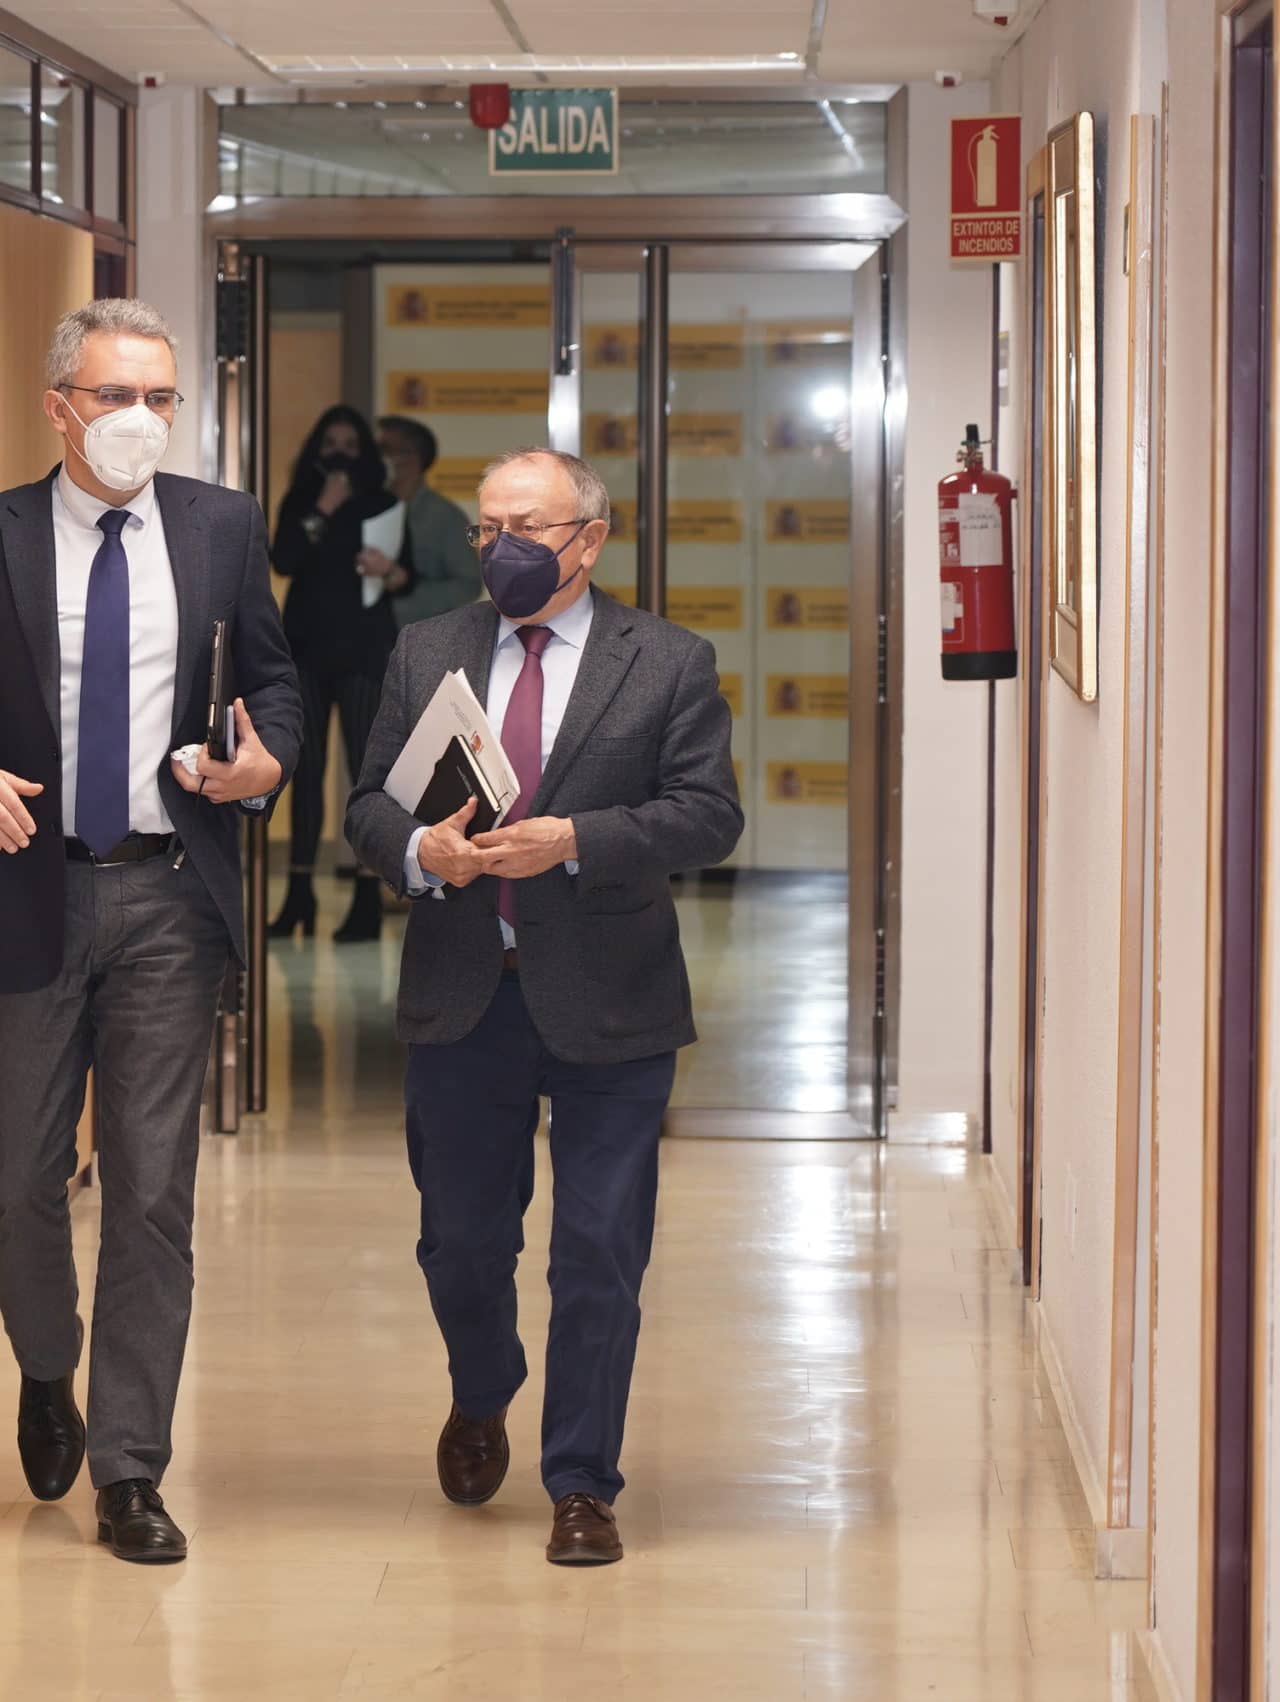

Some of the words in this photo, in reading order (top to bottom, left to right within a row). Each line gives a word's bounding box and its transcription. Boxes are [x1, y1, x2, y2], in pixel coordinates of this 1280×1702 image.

[498, 106, 610, 154] SALIDA
[953, 221, 1003, 236] EXTINTOR
[1006, 221, 1019, 235] DE
[959, 238, 1013, 252] INCENDIOS
